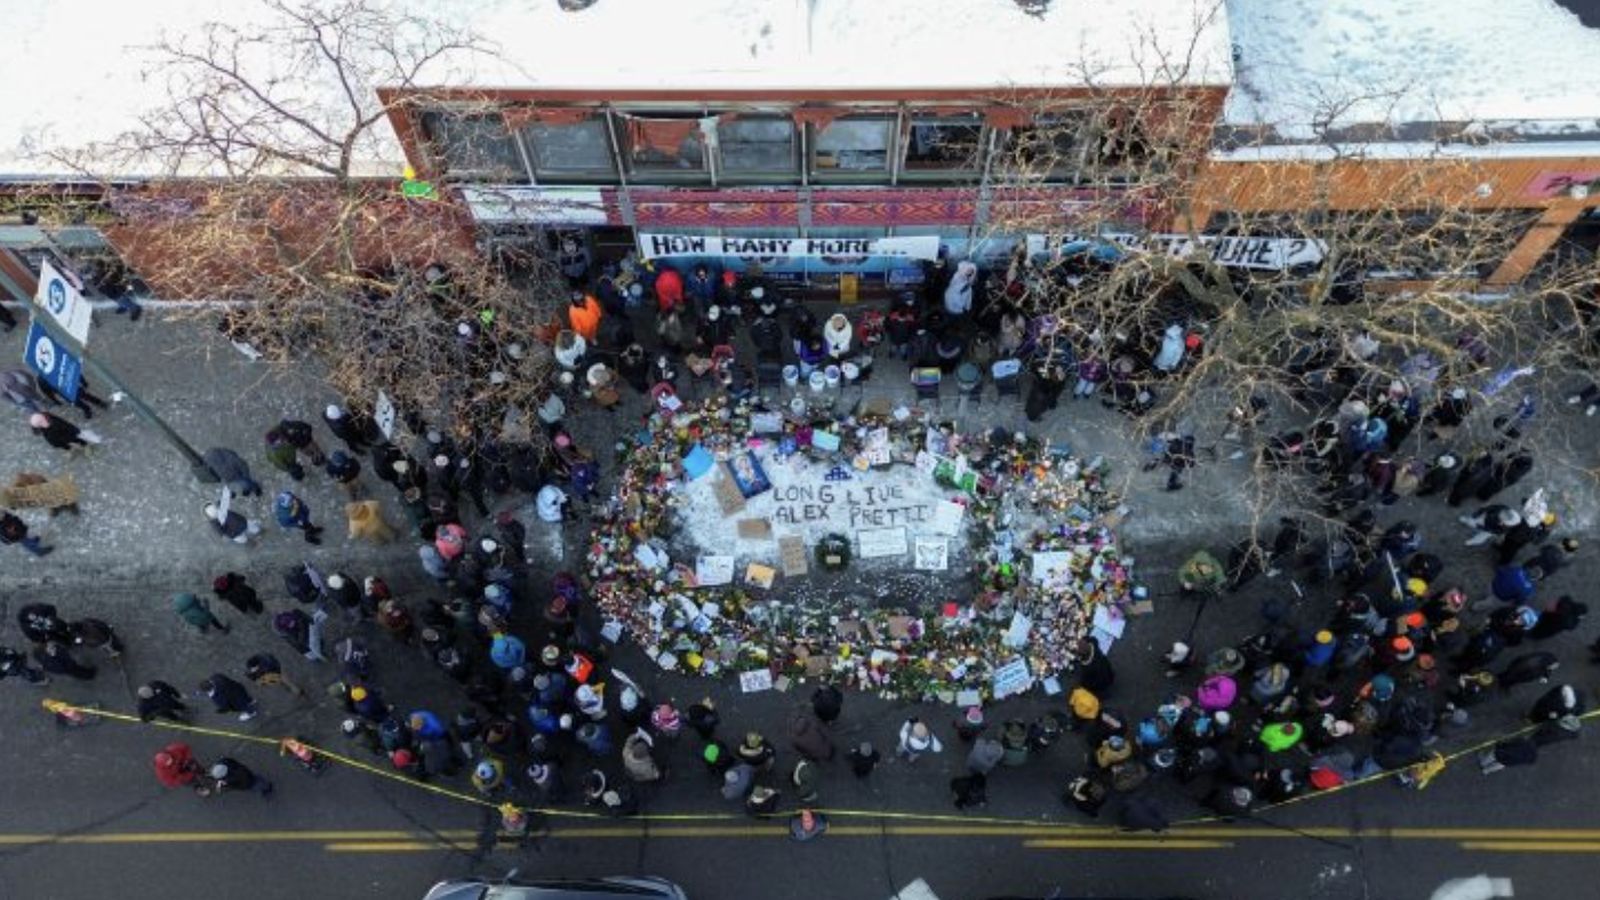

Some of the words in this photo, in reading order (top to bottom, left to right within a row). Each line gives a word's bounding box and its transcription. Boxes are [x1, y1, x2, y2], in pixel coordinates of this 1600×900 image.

[651, 235, 706, 255] HOW
[721, 239, 793, 254] MANY
[773, 484, 835, 504] LONG
[775, 505, 830, 524] ALEX
[850, 504, 928, 527] PRETTI
